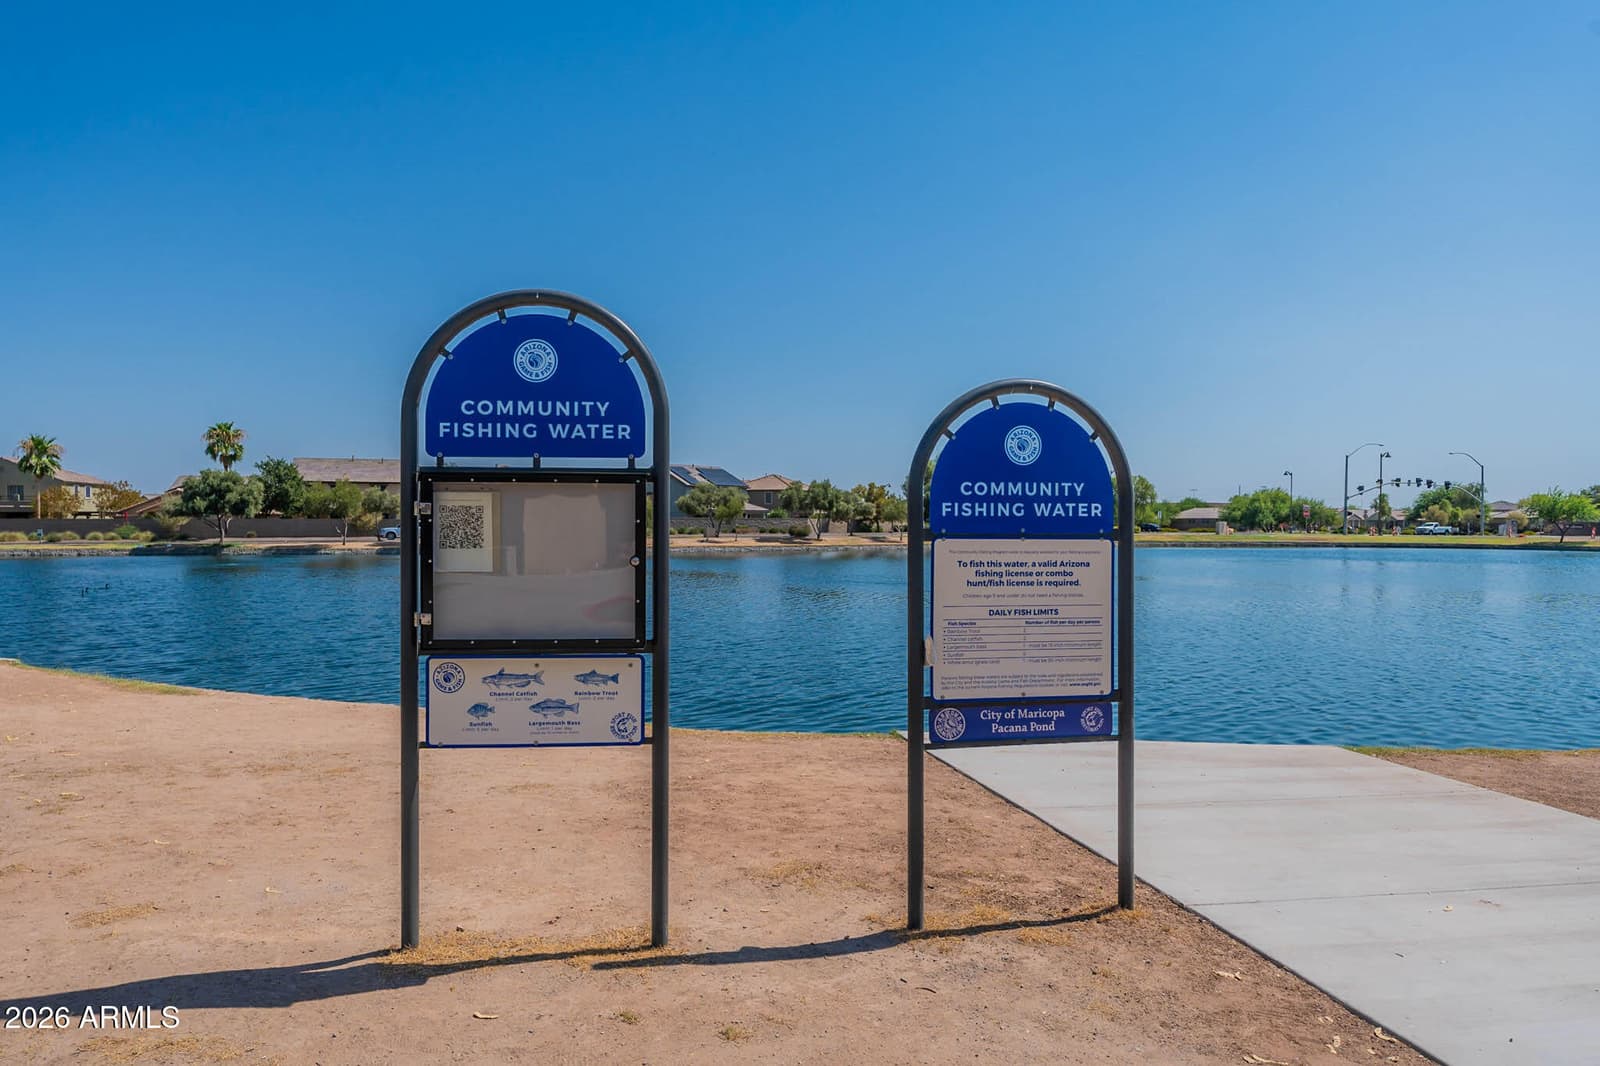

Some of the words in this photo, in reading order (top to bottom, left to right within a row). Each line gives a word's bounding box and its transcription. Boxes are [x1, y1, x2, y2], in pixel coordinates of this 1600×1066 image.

[520, 343, 552, 357] ARIZONA
[540, 361, 553, 376] FISH
[460, 400, 610, 417] COMMUNITY
[439, 422, 538, 439] FISHING
[548, 423, 631, 440] WATER
[960, 481, 1085, 497] COMMUNITY
[941, 502, 1025, 517] FISHING
[1033, 503, 1103, 517] WATER
[957, 560, 968, 568] To
[969, 560, 985, 568] fish
[986, 560, 1002, 568] this
[1003, 561, 1030, 569] water,
[1037, 560, 1058, 568] valid
[1058, 560, 1090, 568] Arizona
[975, 569, 1004, 578] fishing
[1005, 569, 1034, 577] license
[966, 579, 1005, 588] hunt/fish
[1006, 579, 1035, 587] license
[1044, 579, 1081, 588] required.
[988, 609, 1013, 617] DAILY
[1033, 608, 1059, 616] LIMITS
[980, 709, 1002, 722] City
[1004, 708, 1016, 719] of
[1017, 707, 1065, 721] Maricopa
[991, 723, 1028, 734] Pacana
[1029, 720, 1056, 732] Pond
